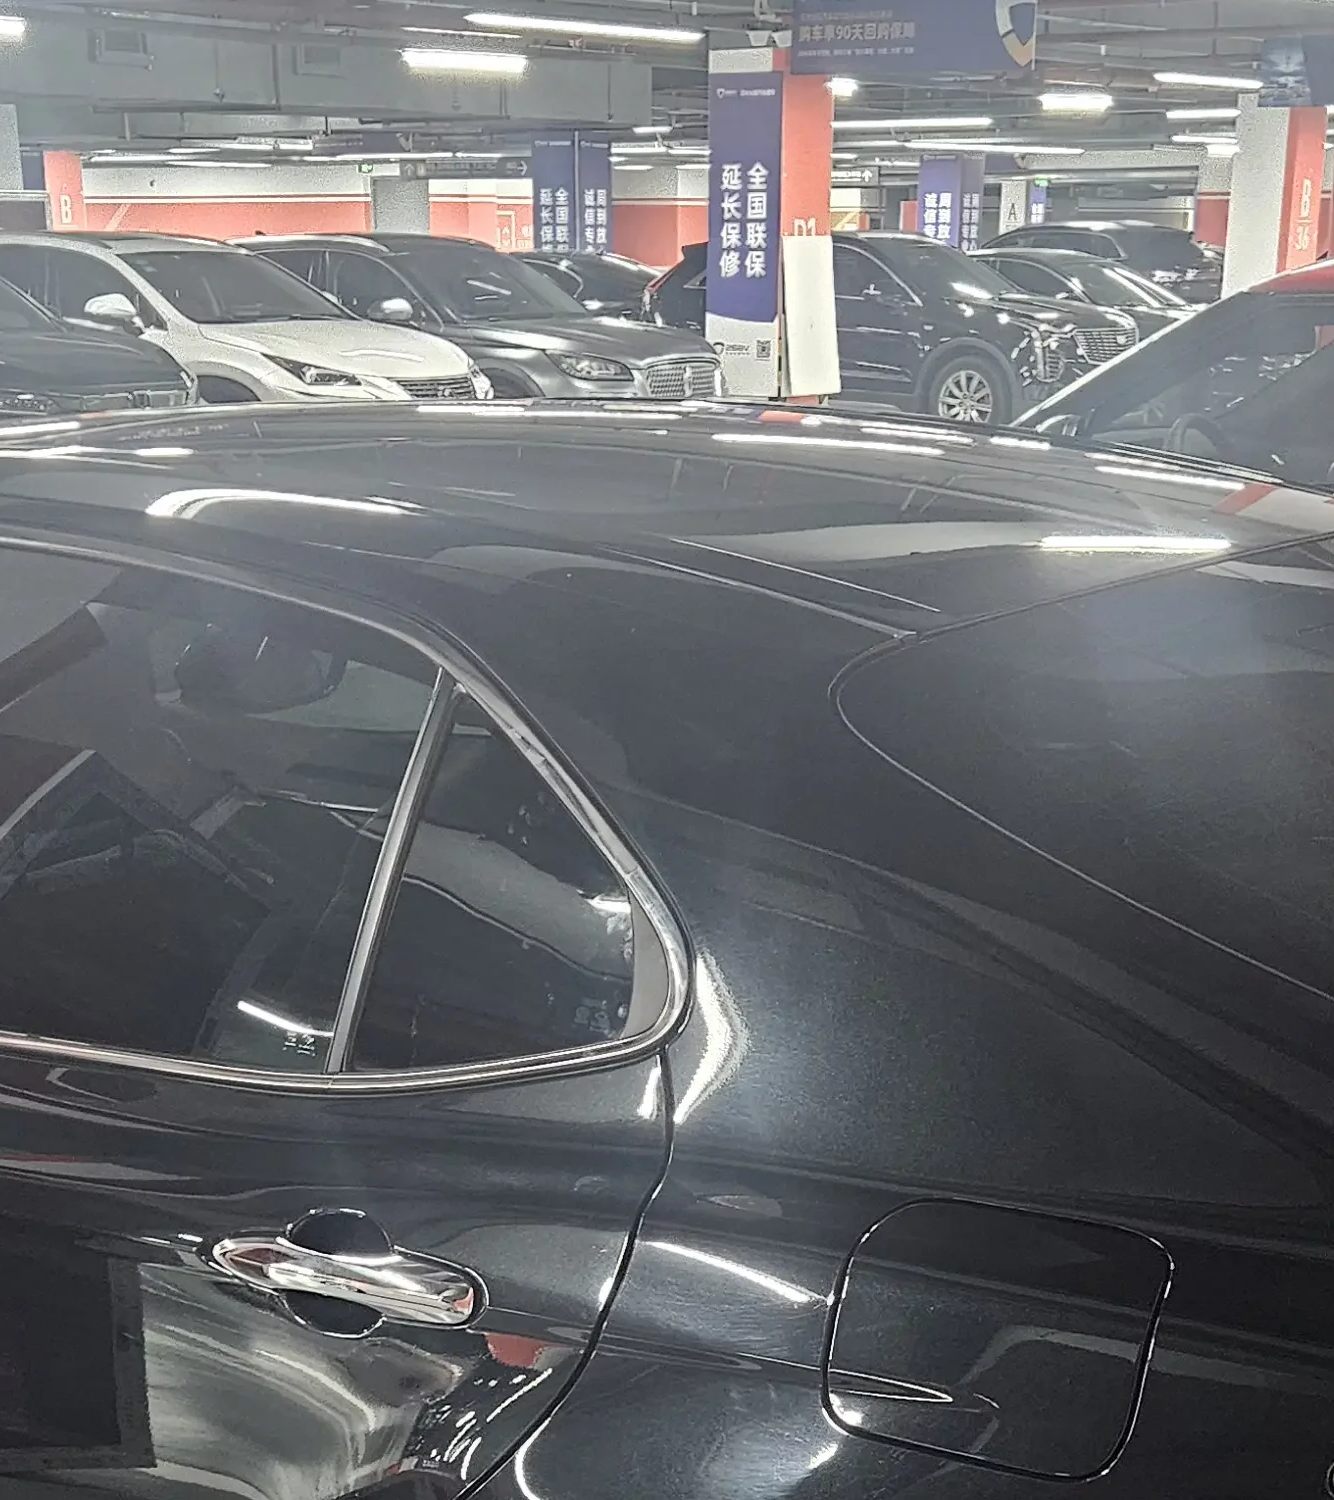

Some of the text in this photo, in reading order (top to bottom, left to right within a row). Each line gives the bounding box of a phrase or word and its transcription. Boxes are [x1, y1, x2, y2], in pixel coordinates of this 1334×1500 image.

[60, 195, 73, 225] B
[1007, 202, 1018, 221] A
[1300, 179, 1312, 217] B
[719, 163, 742, 278] 延长保修
[744, 162, 769, 278] 全国联保
